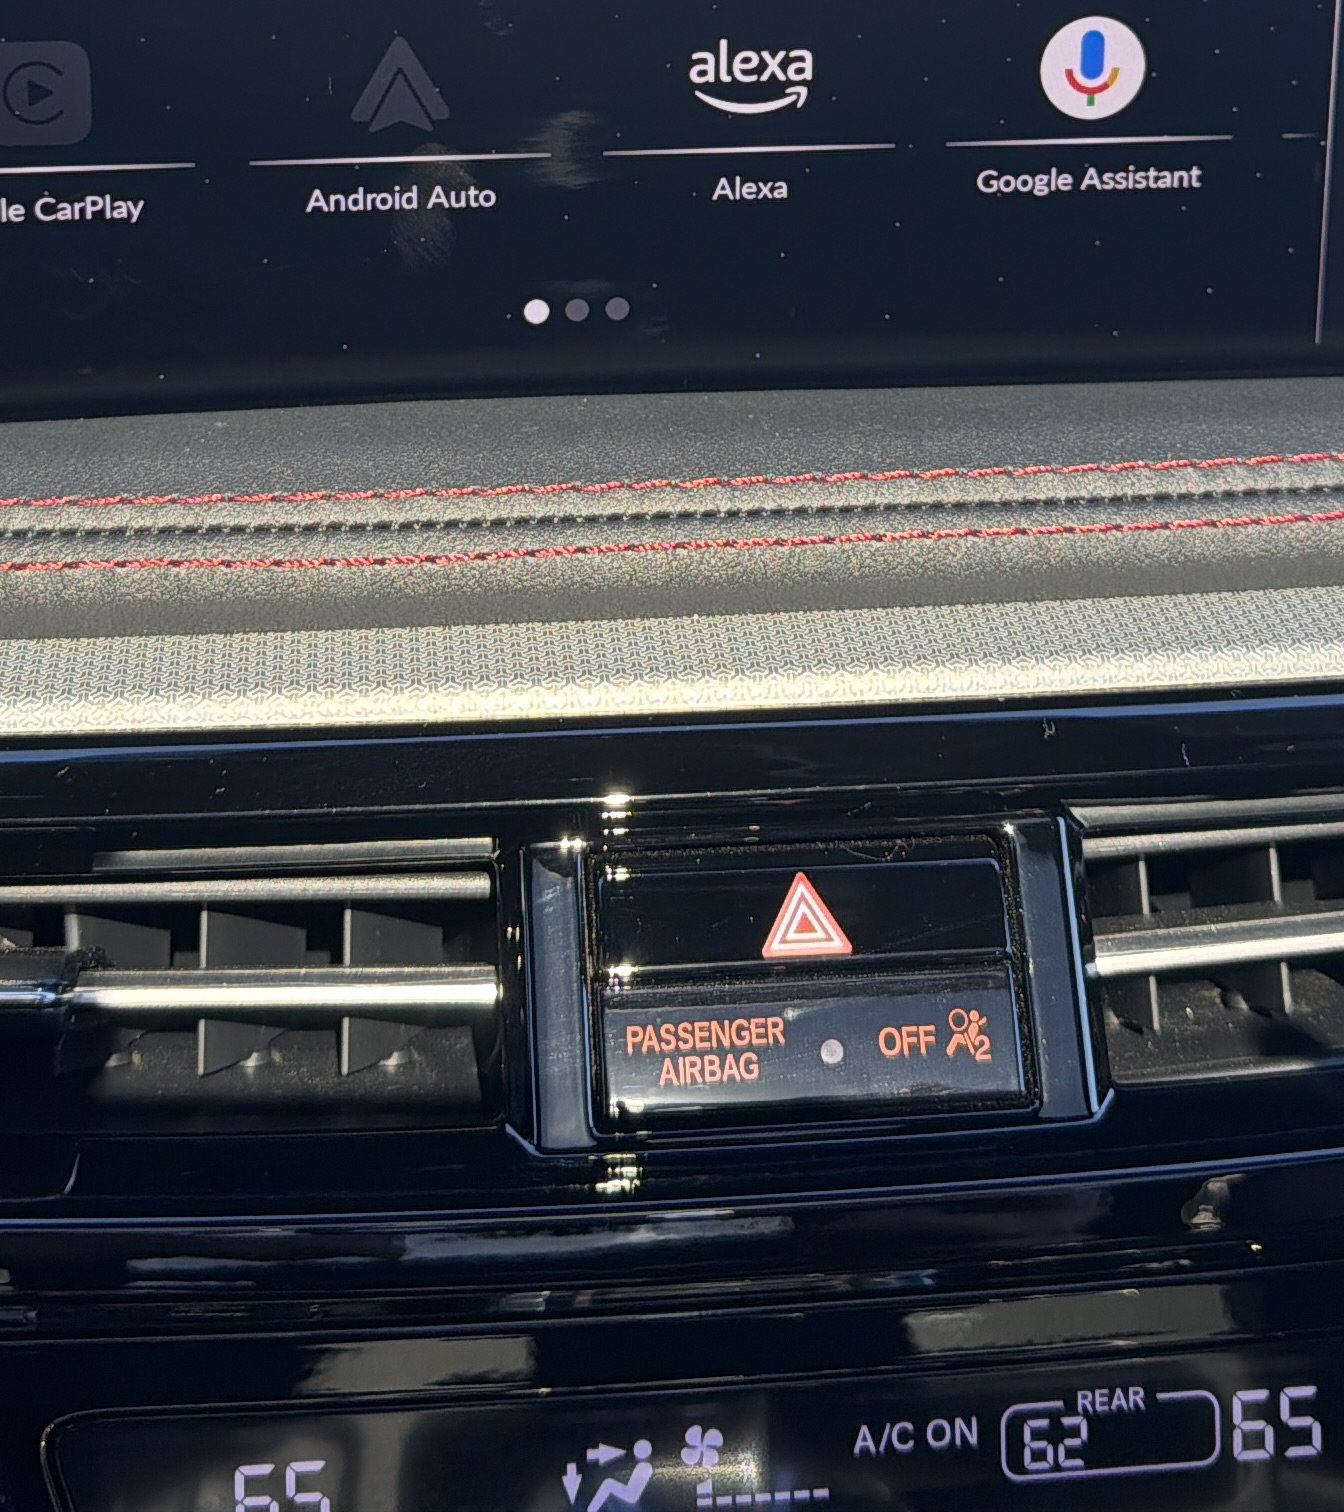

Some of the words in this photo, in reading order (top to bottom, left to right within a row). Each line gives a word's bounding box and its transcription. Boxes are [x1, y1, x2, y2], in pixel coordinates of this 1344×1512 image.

[690, 39, 813, 84] alexa
[712, 176, 787, 200] Alexa
[977, 167, 1073, 196] Google
[1080, 166, 1202, 190] Assistant
[35, 196, 144, 224] CarPlay
[306, 185, 417, 212] Android
[427, 186, 496, 209] Auto
[626, 1017, 785, 1055] PASSENGER
[879, 1026, 937, 1057] OFF
[659, 1051, 760, 1086] AIRBAG
[1077, 1387, 1146, 1414] REAR
[854, 1424, 914, 1456] A/C
[927, 1417, 977, 1448] ON
[1233, 1386, 1321, 1461] 65
[1023, 1417, 1088, 1471] 62
